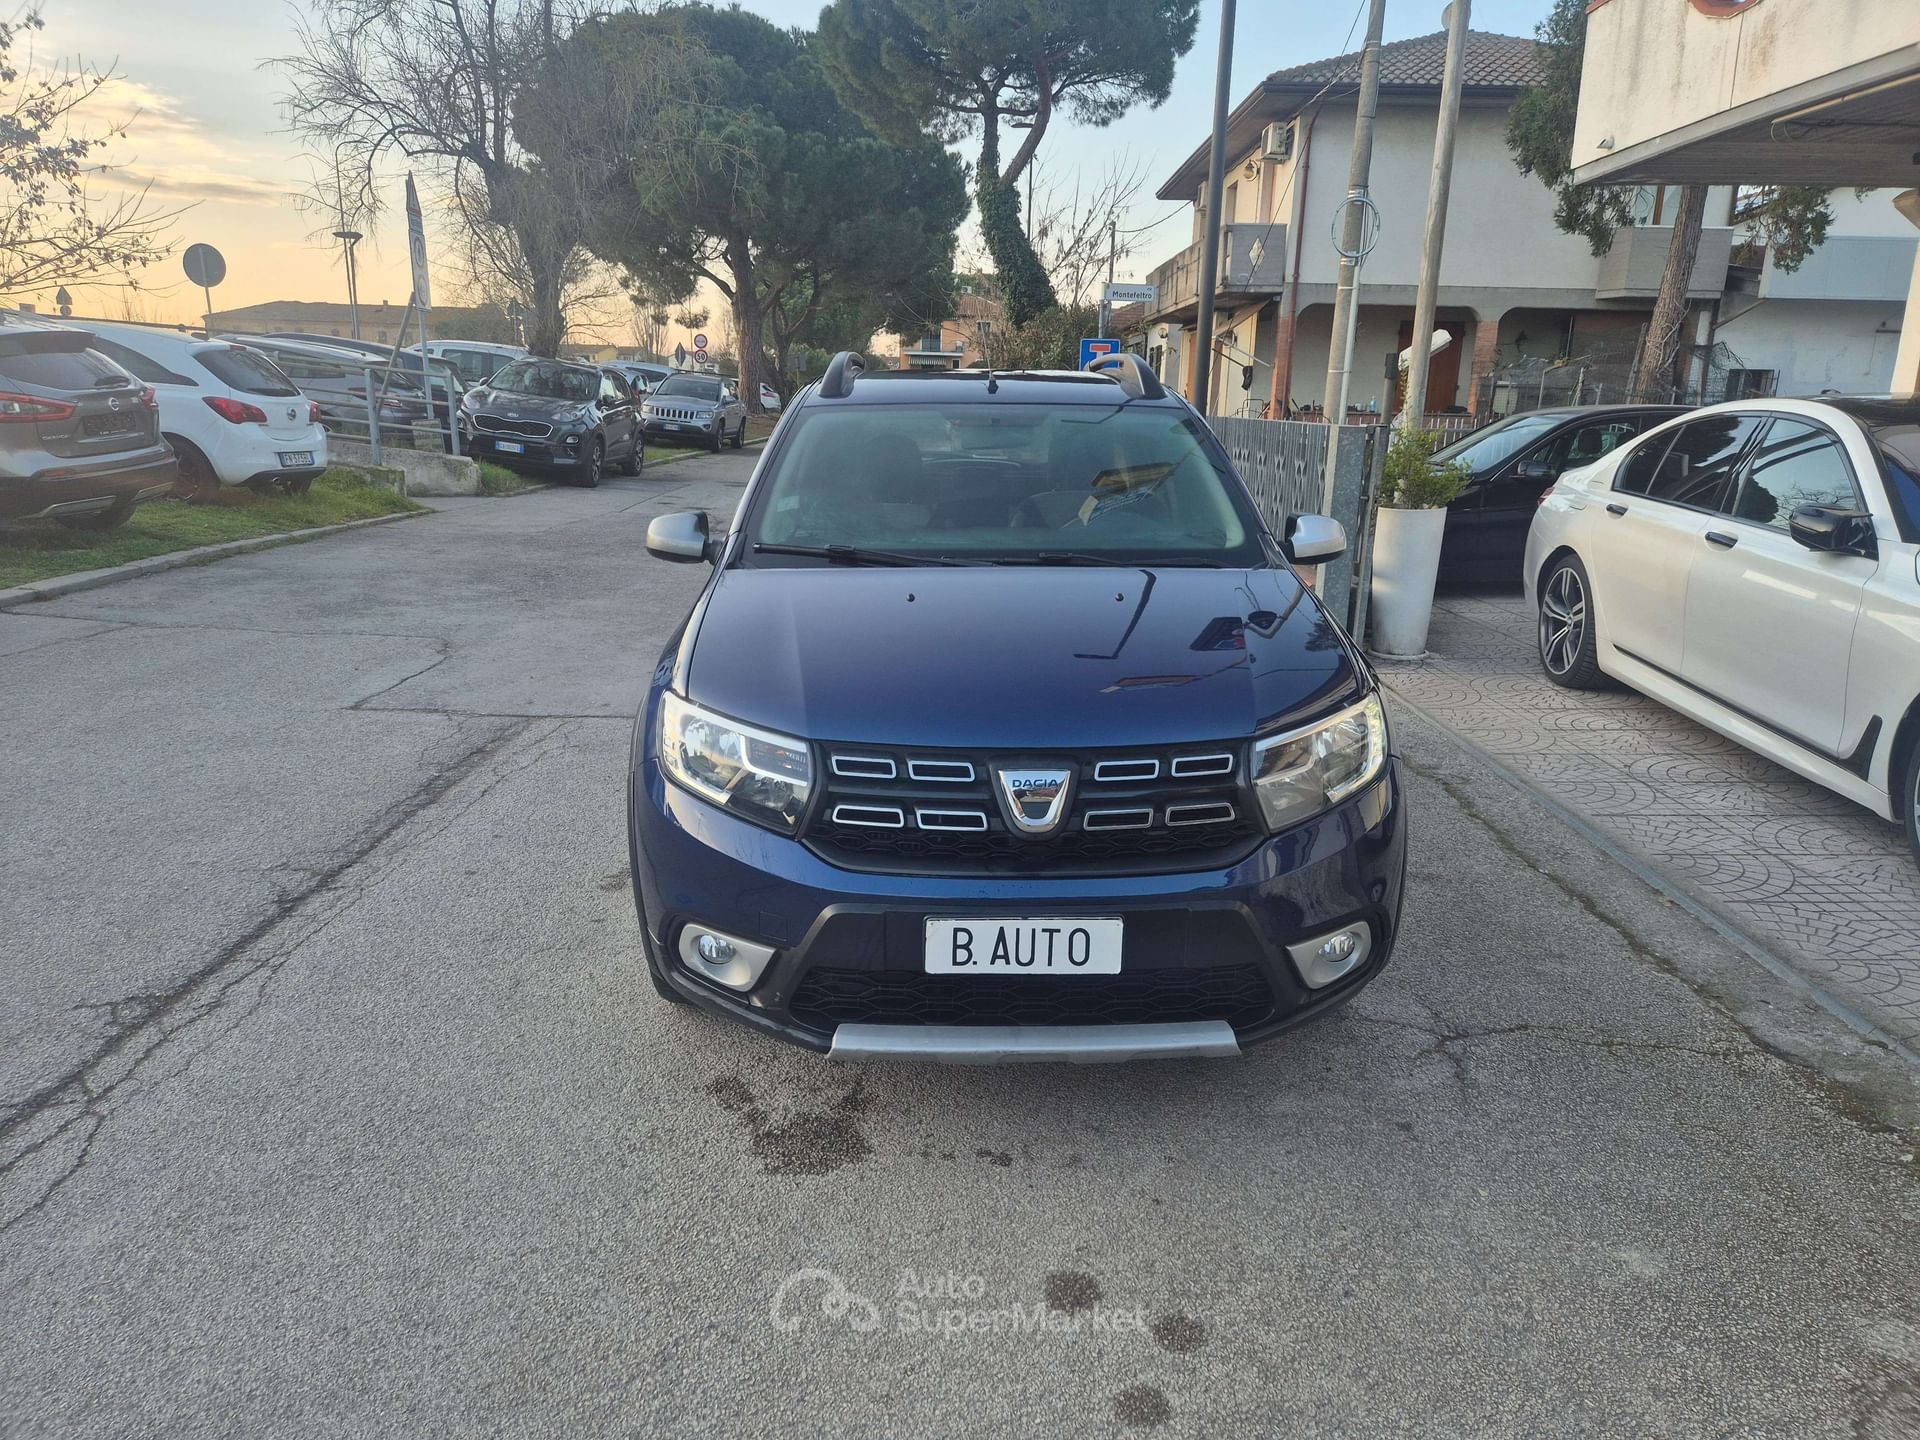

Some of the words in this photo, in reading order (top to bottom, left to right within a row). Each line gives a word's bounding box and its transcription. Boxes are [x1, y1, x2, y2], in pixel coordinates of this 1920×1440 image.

[1112, 290, 1152, 299] Montefeltro
[1012, 779, 1059, 788] DACIA
[951, 926, 978, 967] B.
[989, 926, 1091, 967] AUTO
